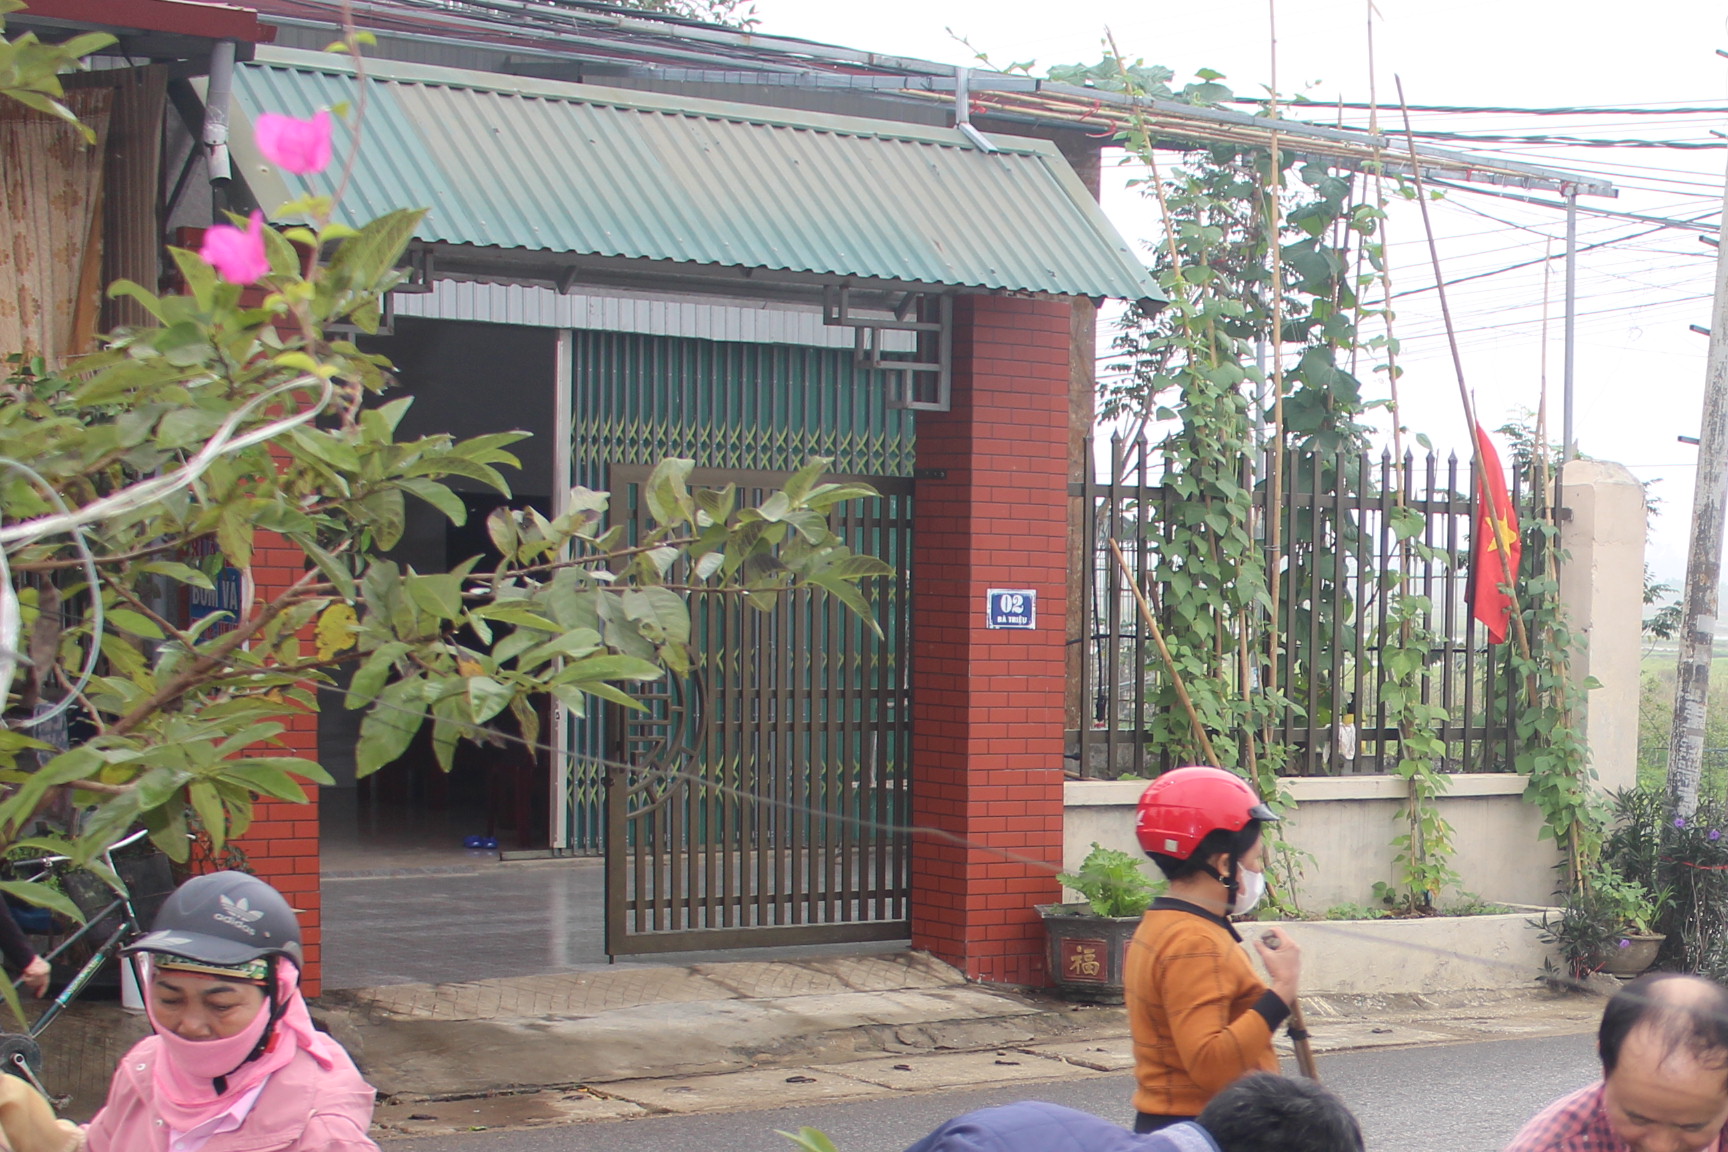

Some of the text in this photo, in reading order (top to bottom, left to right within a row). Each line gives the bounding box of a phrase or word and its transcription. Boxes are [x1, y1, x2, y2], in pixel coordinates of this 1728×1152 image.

[222, 575, 238, 610] VÁ
[1000, 594, 1024, 614] 02
[1008, 614, 1028, 625] TRIỆU
[212, 912, 256, 936] adidas
[1069, 945, 1100, 976] 福
